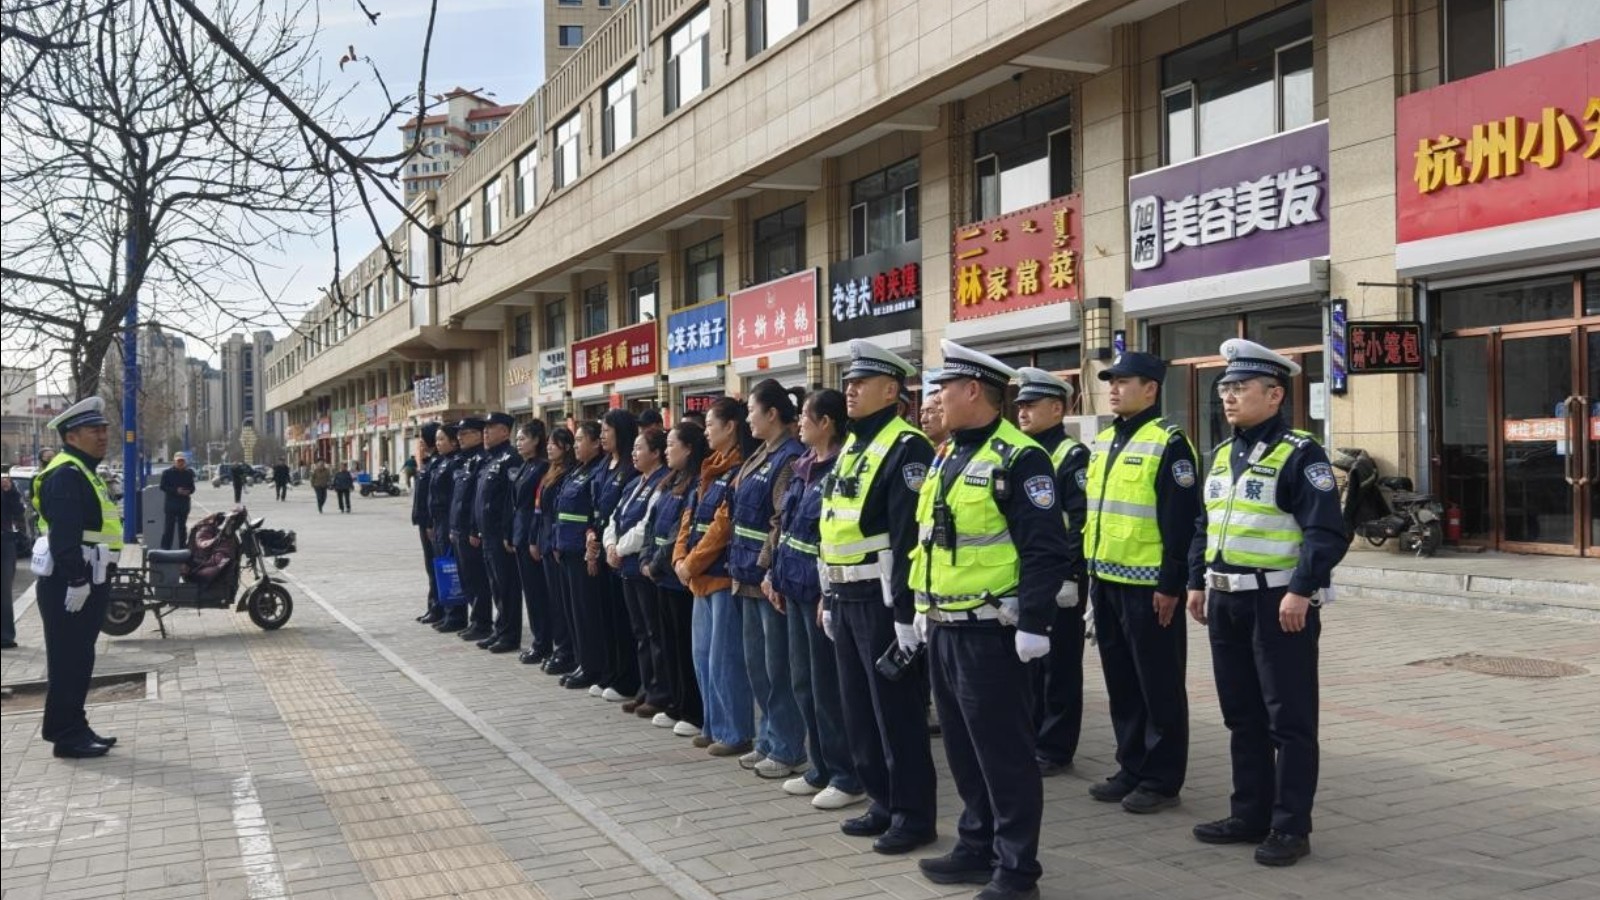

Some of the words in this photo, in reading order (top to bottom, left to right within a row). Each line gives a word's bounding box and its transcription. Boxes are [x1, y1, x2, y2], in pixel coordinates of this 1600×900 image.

[1163, 165, 1321, 253] 美容美发
[1352, 328, 1365, 368] 杭州
[1367, 331, 1420, 364] 小笼包
